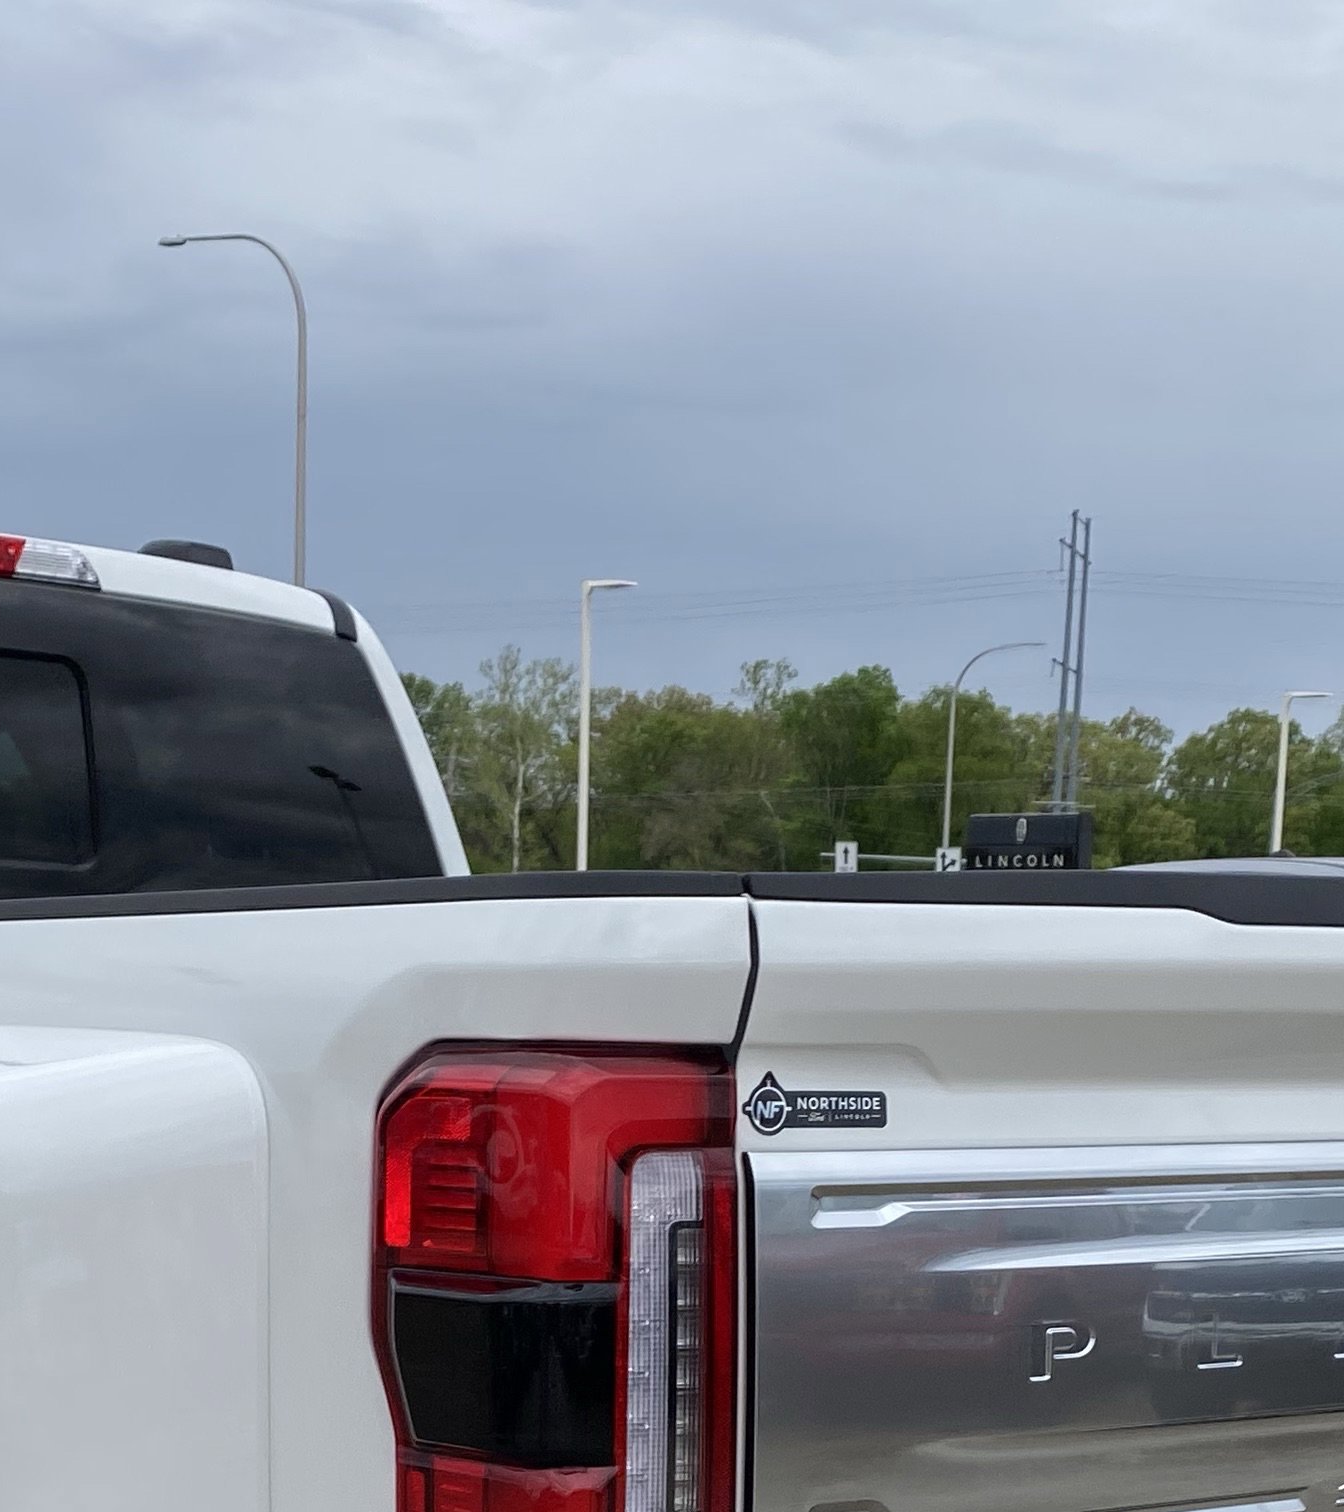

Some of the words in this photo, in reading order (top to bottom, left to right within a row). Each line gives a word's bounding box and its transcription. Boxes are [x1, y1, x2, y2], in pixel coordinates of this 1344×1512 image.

[975, 854, 1064, 867] LINCOLN
[797, 1097, 881, 1110] NORTHSIDE
[756, 1101, 785, 1121] NF
